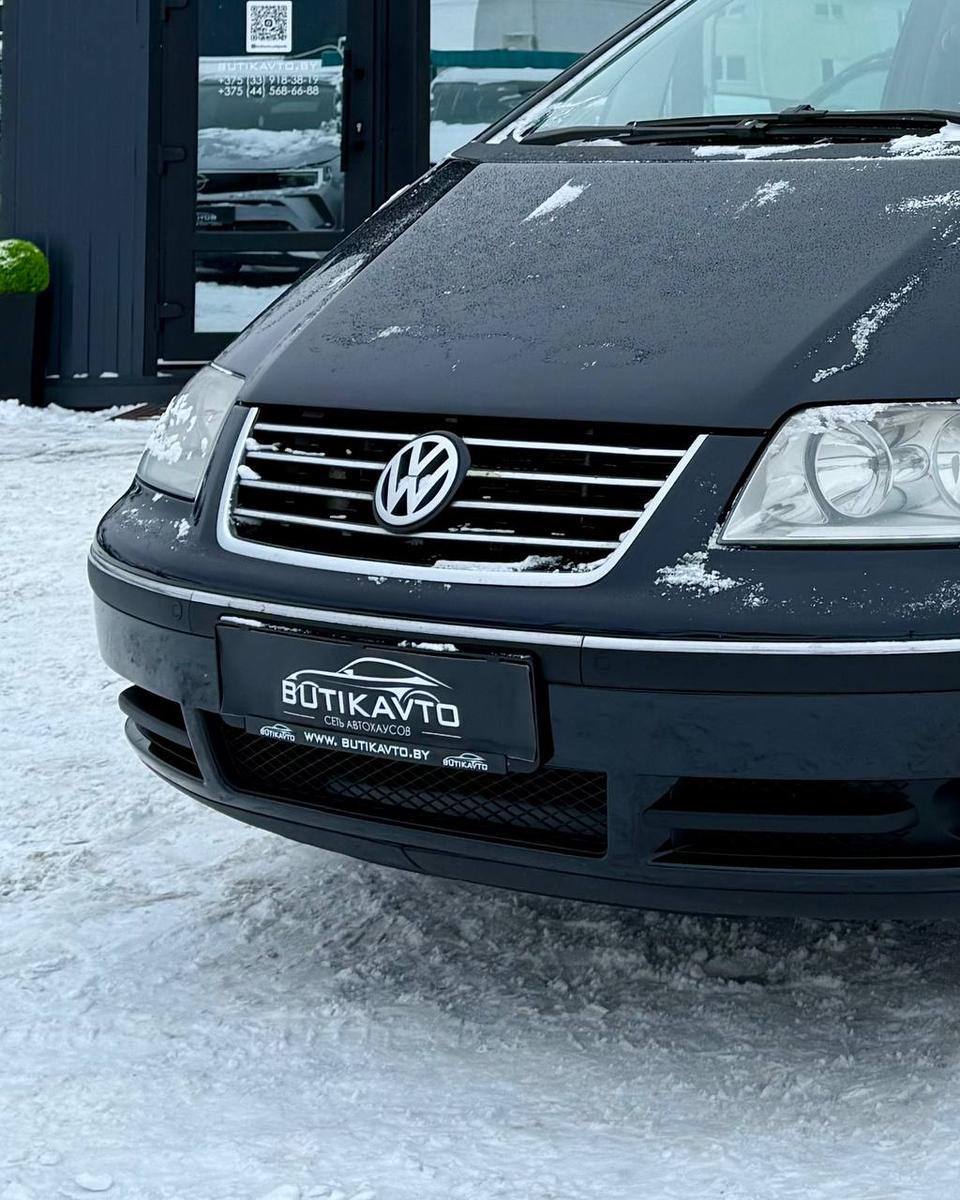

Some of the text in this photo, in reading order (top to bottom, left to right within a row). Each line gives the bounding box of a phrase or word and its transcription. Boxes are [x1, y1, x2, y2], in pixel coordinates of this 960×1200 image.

[218, 85, 319, 98] +375 (44) 568-66-88
[282, 679, 460, 728] BUTIKAVTO
[324, 715, 411, 737] СЕТЬ АВТОХАУСОВ
[341, 737, 430, 761] BUTIKAVTO.BY
[442, 758, 488, 771] BUTIKAVTO
